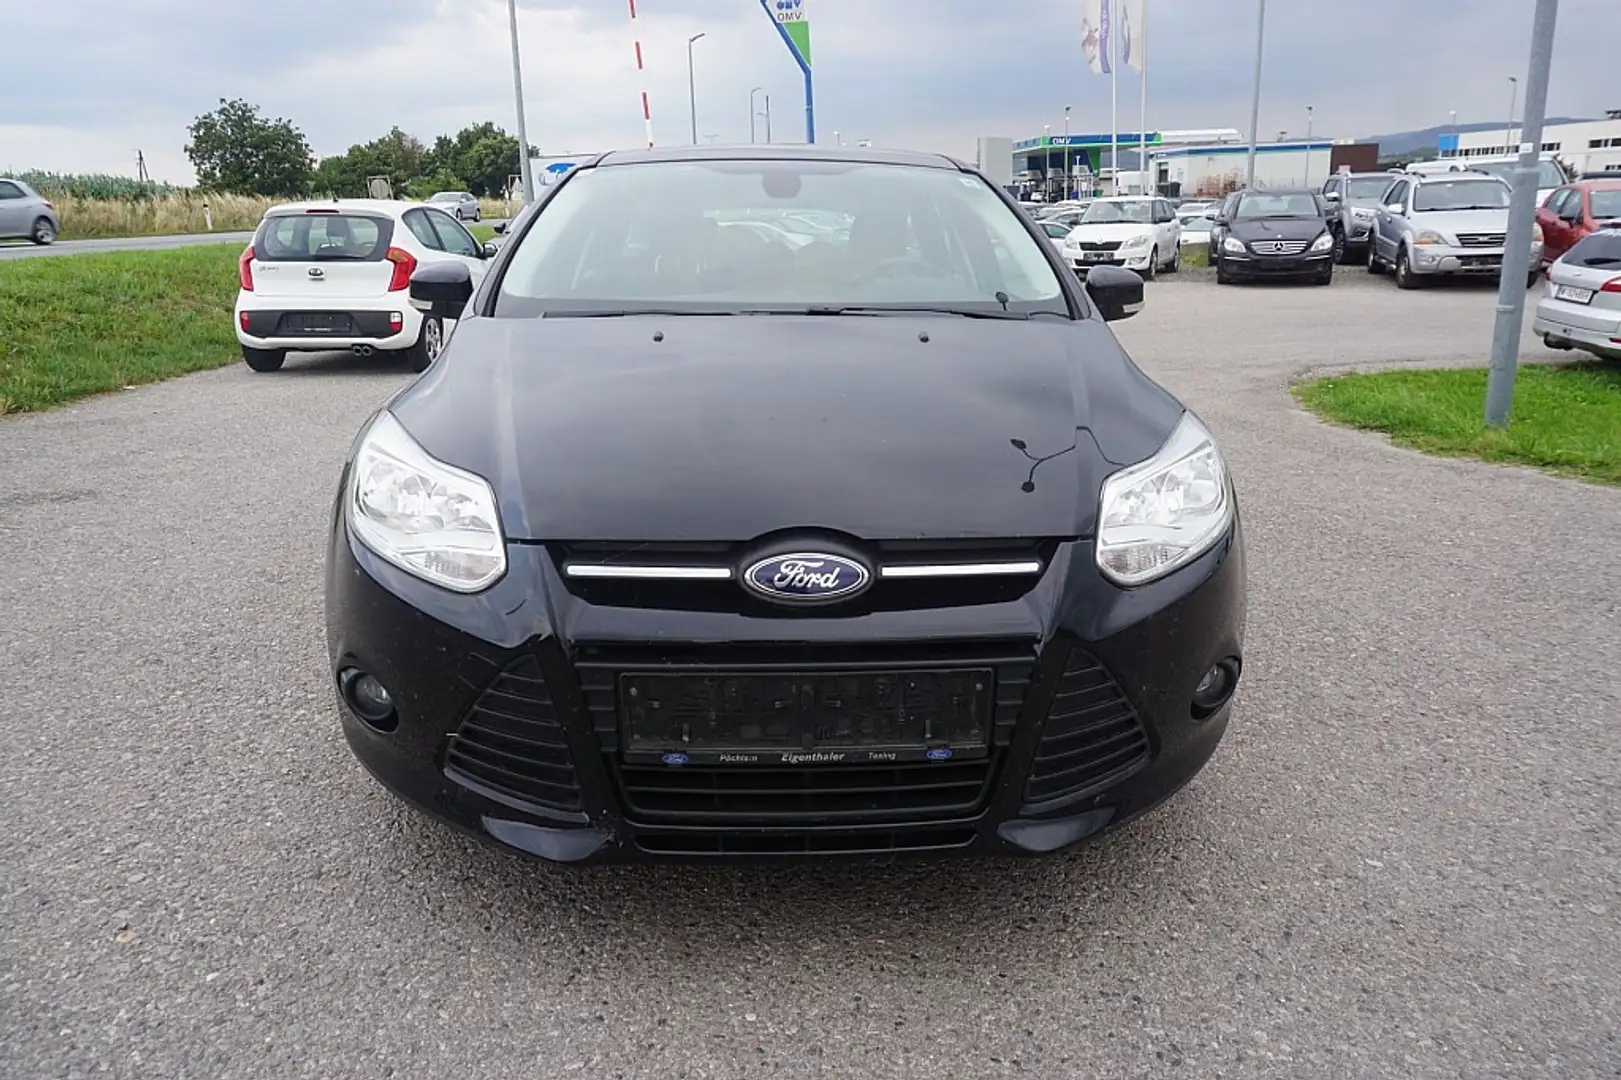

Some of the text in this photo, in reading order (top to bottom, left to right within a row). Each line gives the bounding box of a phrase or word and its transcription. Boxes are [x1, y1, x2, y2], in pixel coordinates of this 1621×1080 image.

[777, 12, 802, 21] OMV
[1052, 136, 1072, 145] OMV
[774, 560, 841, 589] Ford
